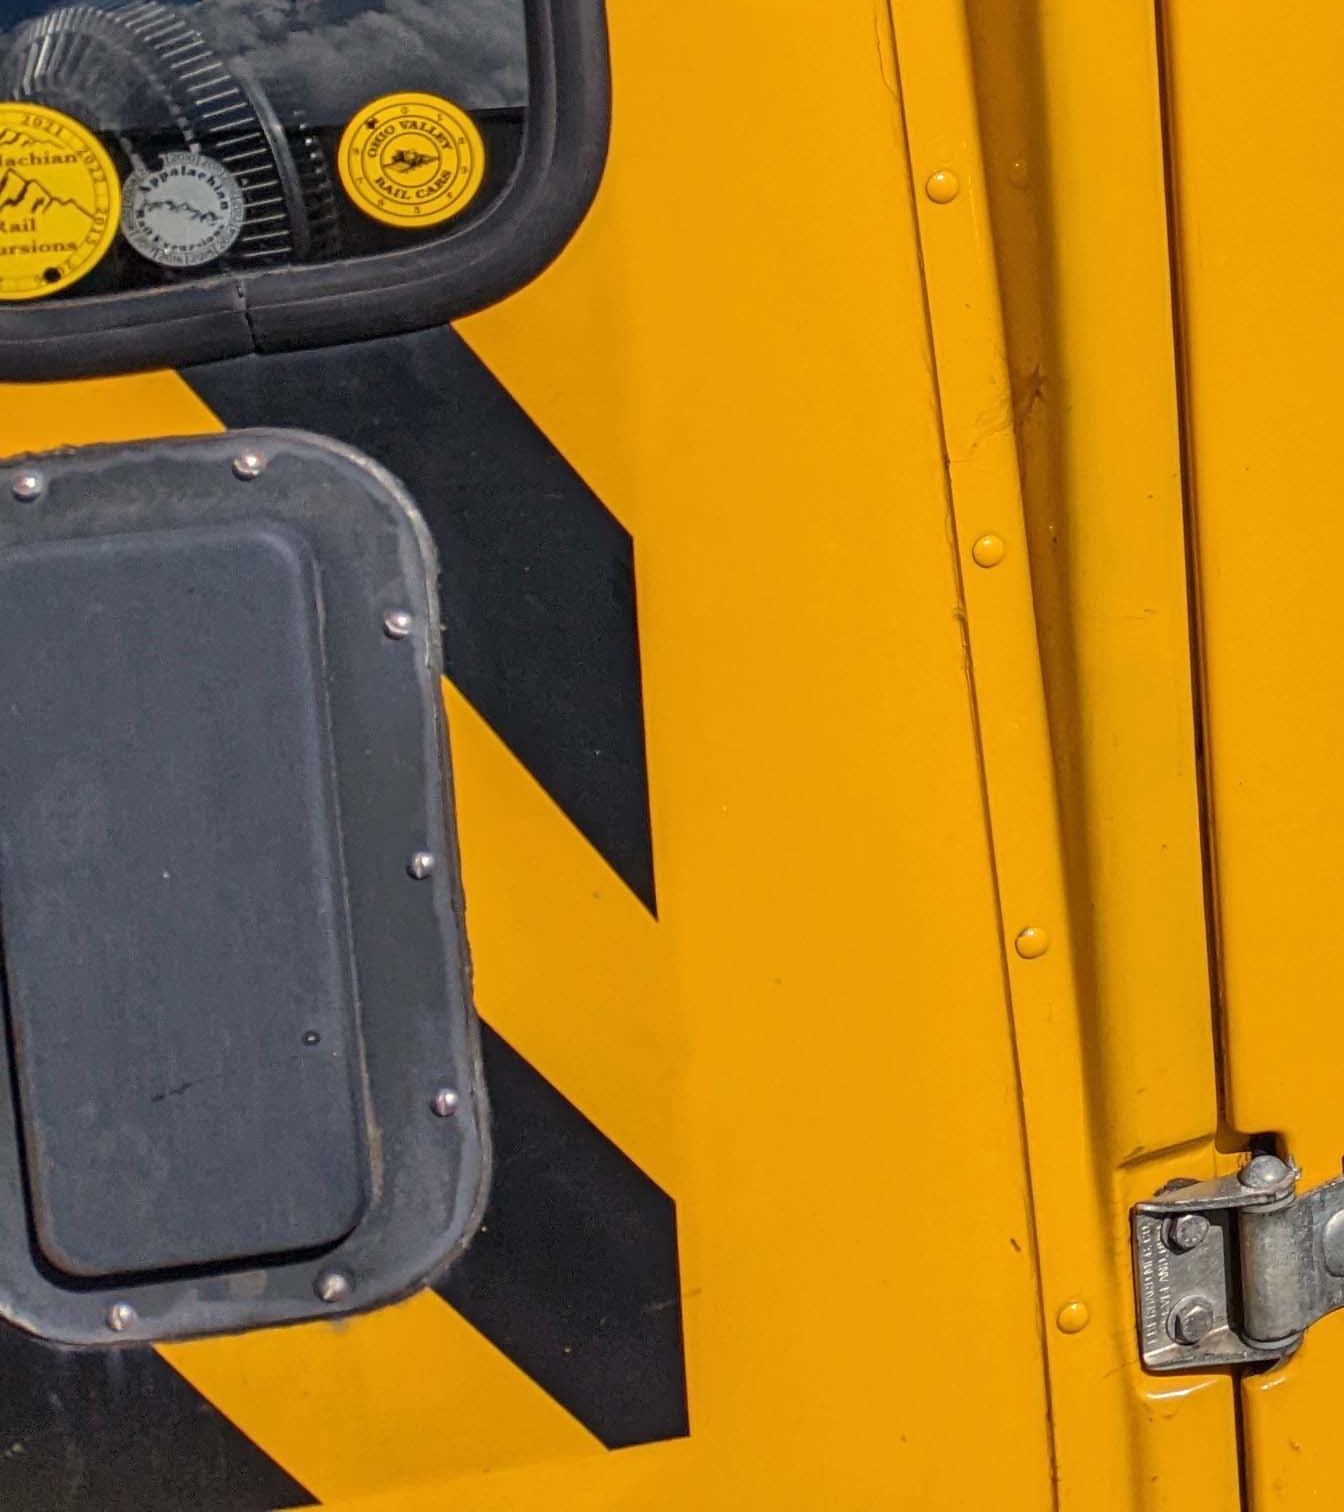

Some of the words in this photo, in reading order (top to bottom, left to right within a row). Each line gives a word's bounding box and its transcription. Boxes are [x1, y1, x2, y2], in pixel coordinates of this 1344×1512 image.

[367, 125, 396, 158] OHIO
[399, 120, 454, 150] VALLEY
[375, 176, 411, 200] RAIL
[415, 170, 452, 199] CARS
